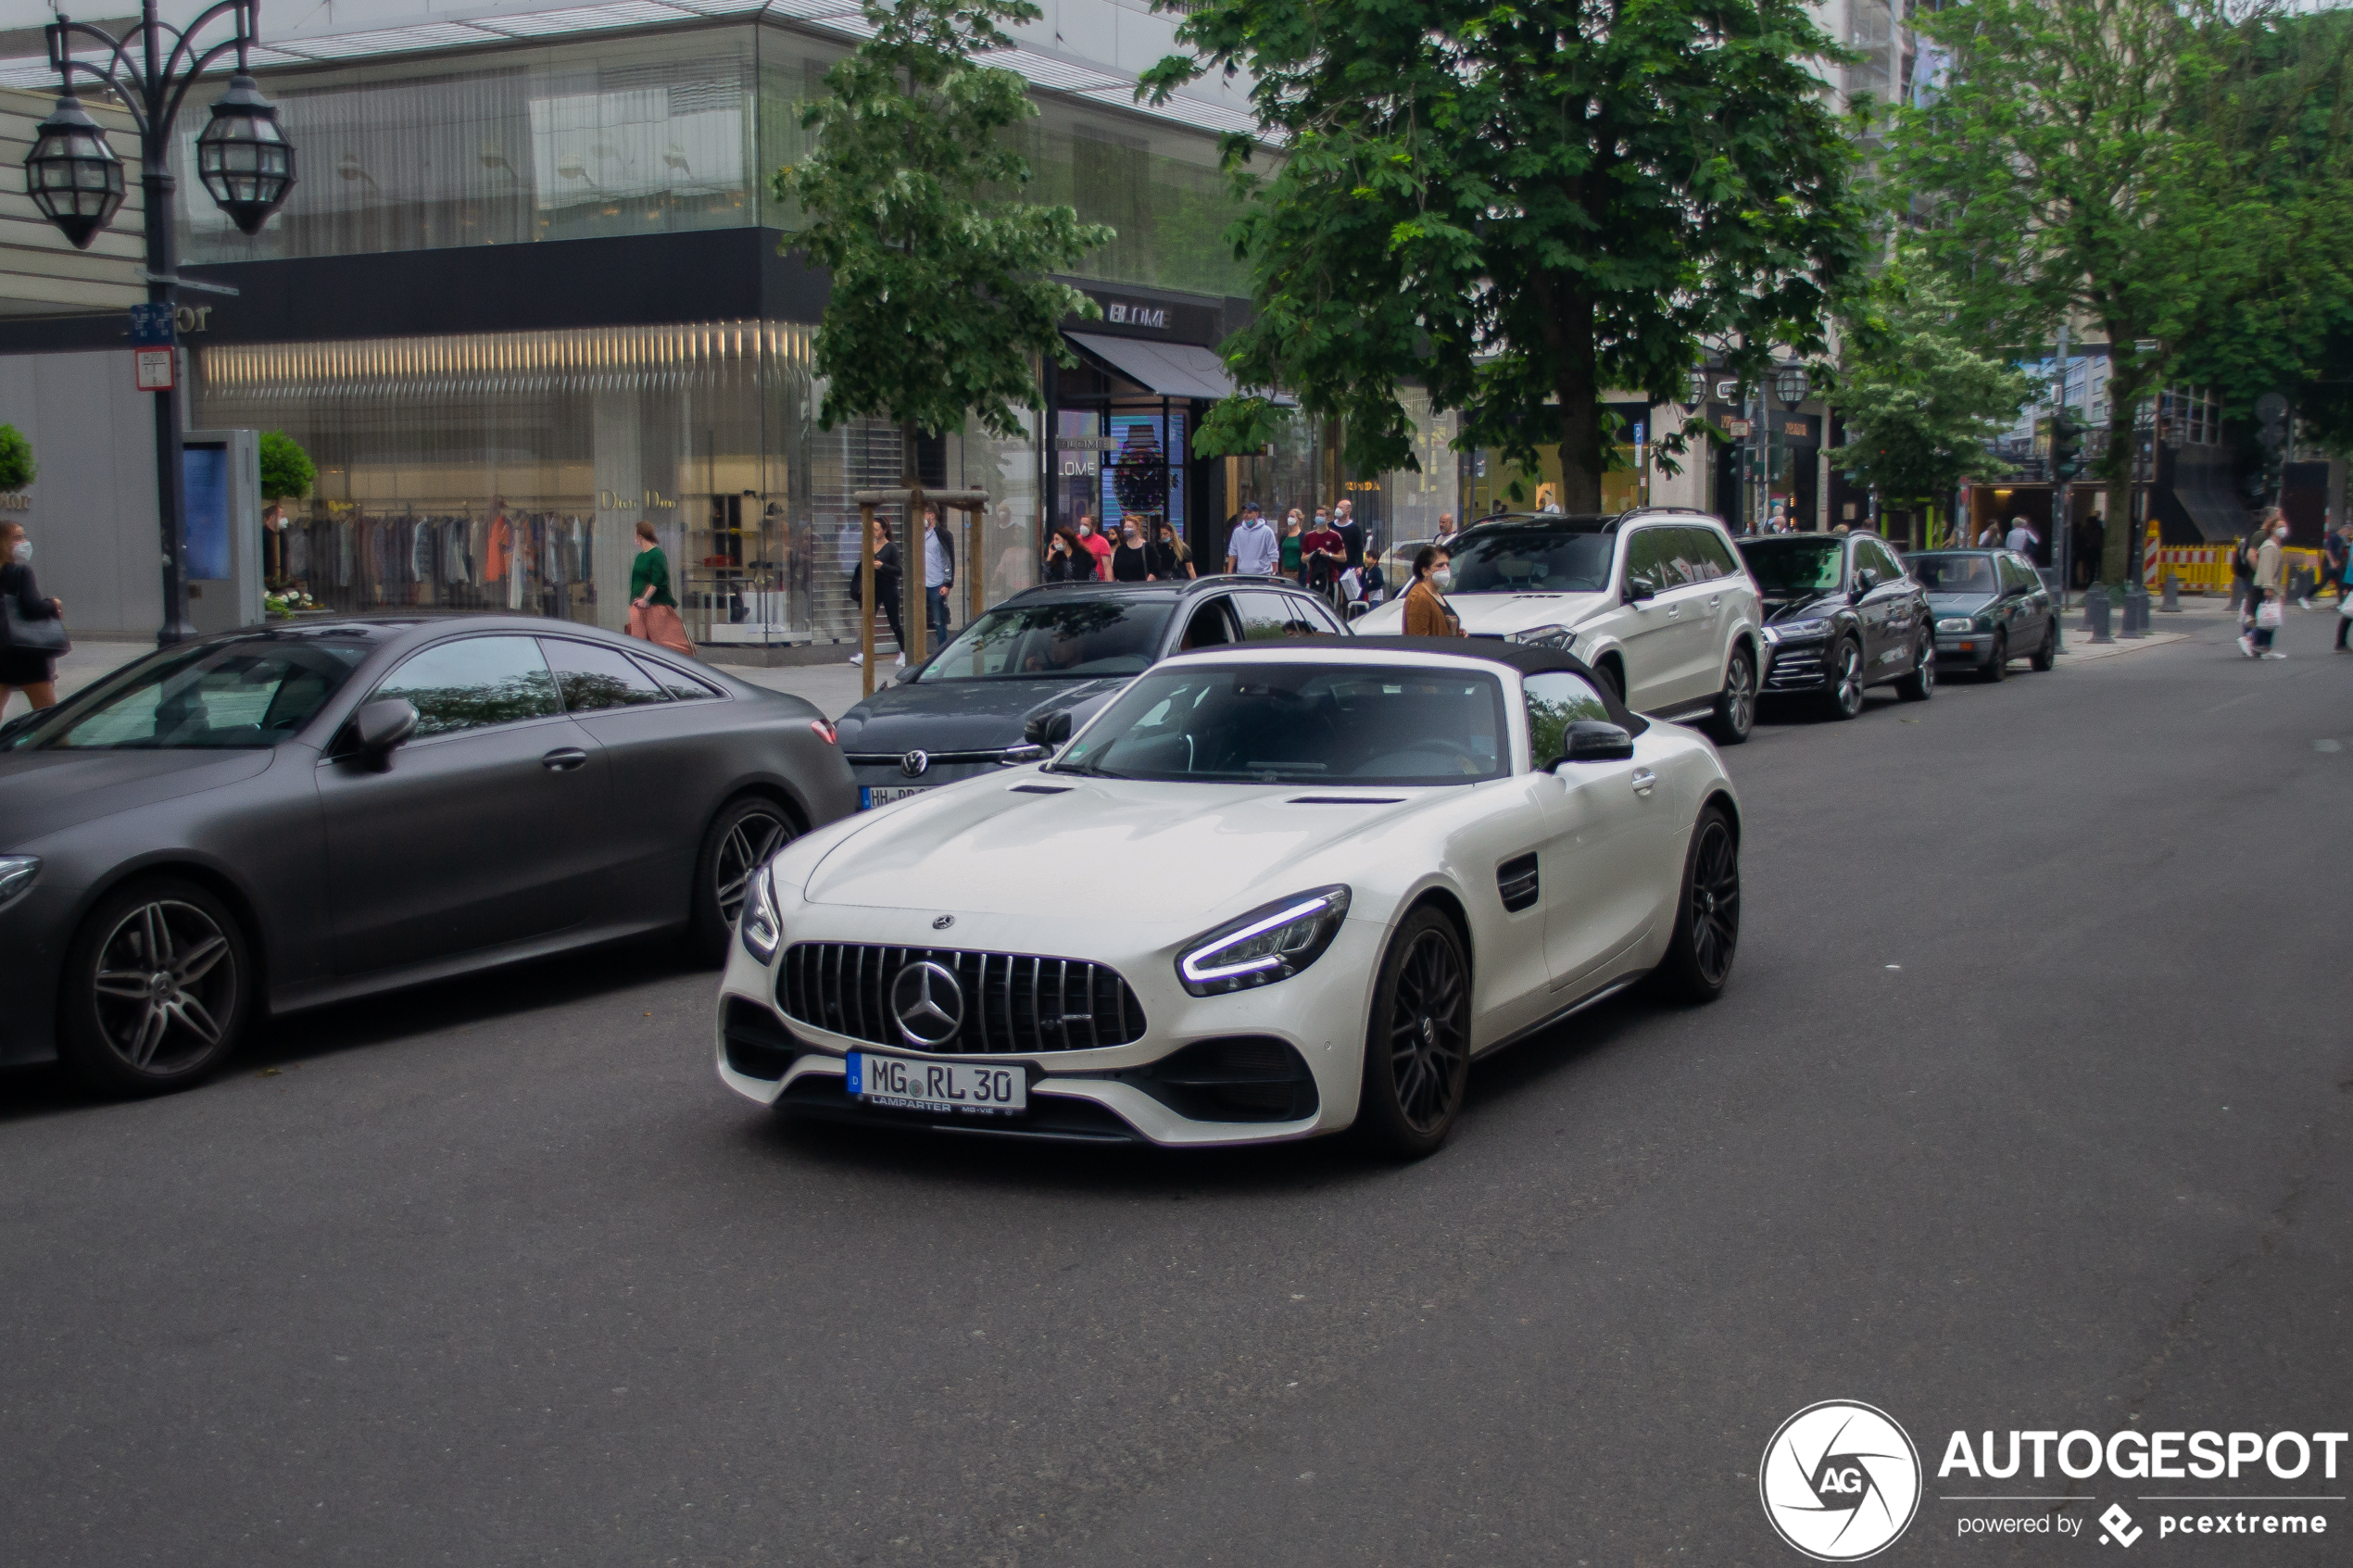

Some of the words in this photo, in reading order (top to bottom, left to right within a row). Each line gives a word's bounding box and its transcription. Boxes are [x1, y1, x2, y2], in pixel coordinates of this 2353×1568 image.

[852, 1076, 859, 1085] D
[872, 1059, 908, 1095] MG
[927, 1065, 966, 1100] RL
[974, 1069, 1012, 1102] 30
[872, 1095, 951, 1112] LAMPARTER
